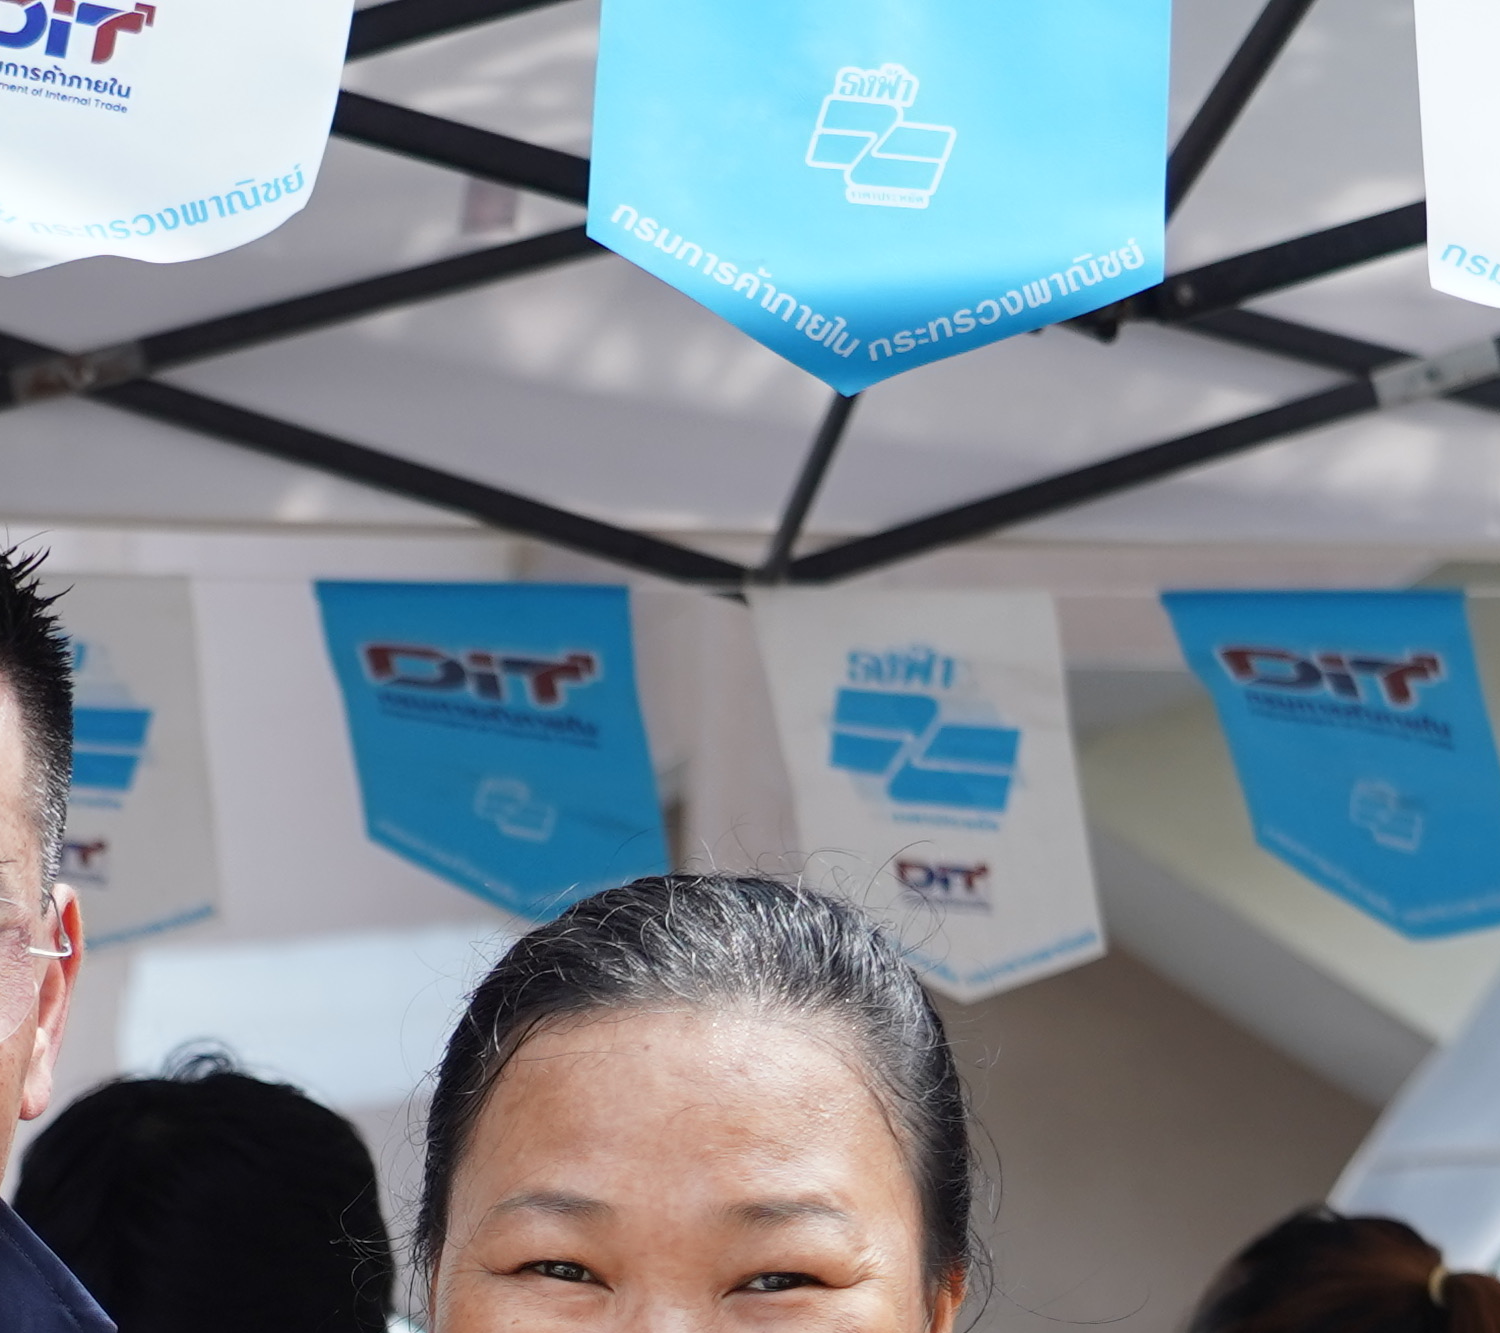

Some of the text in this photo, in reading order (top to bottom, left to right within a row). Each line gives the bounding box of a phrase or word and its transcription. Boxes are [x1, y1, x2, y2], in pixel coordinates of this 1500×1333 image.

[31, 87, 44, 98] of
[46, 89, 92, 108] Internal
[94, 98, 128, 114] Trade
[611, 203, 1147, 361] กรมการค้าภายใน กระทรวงพาณิชย์
